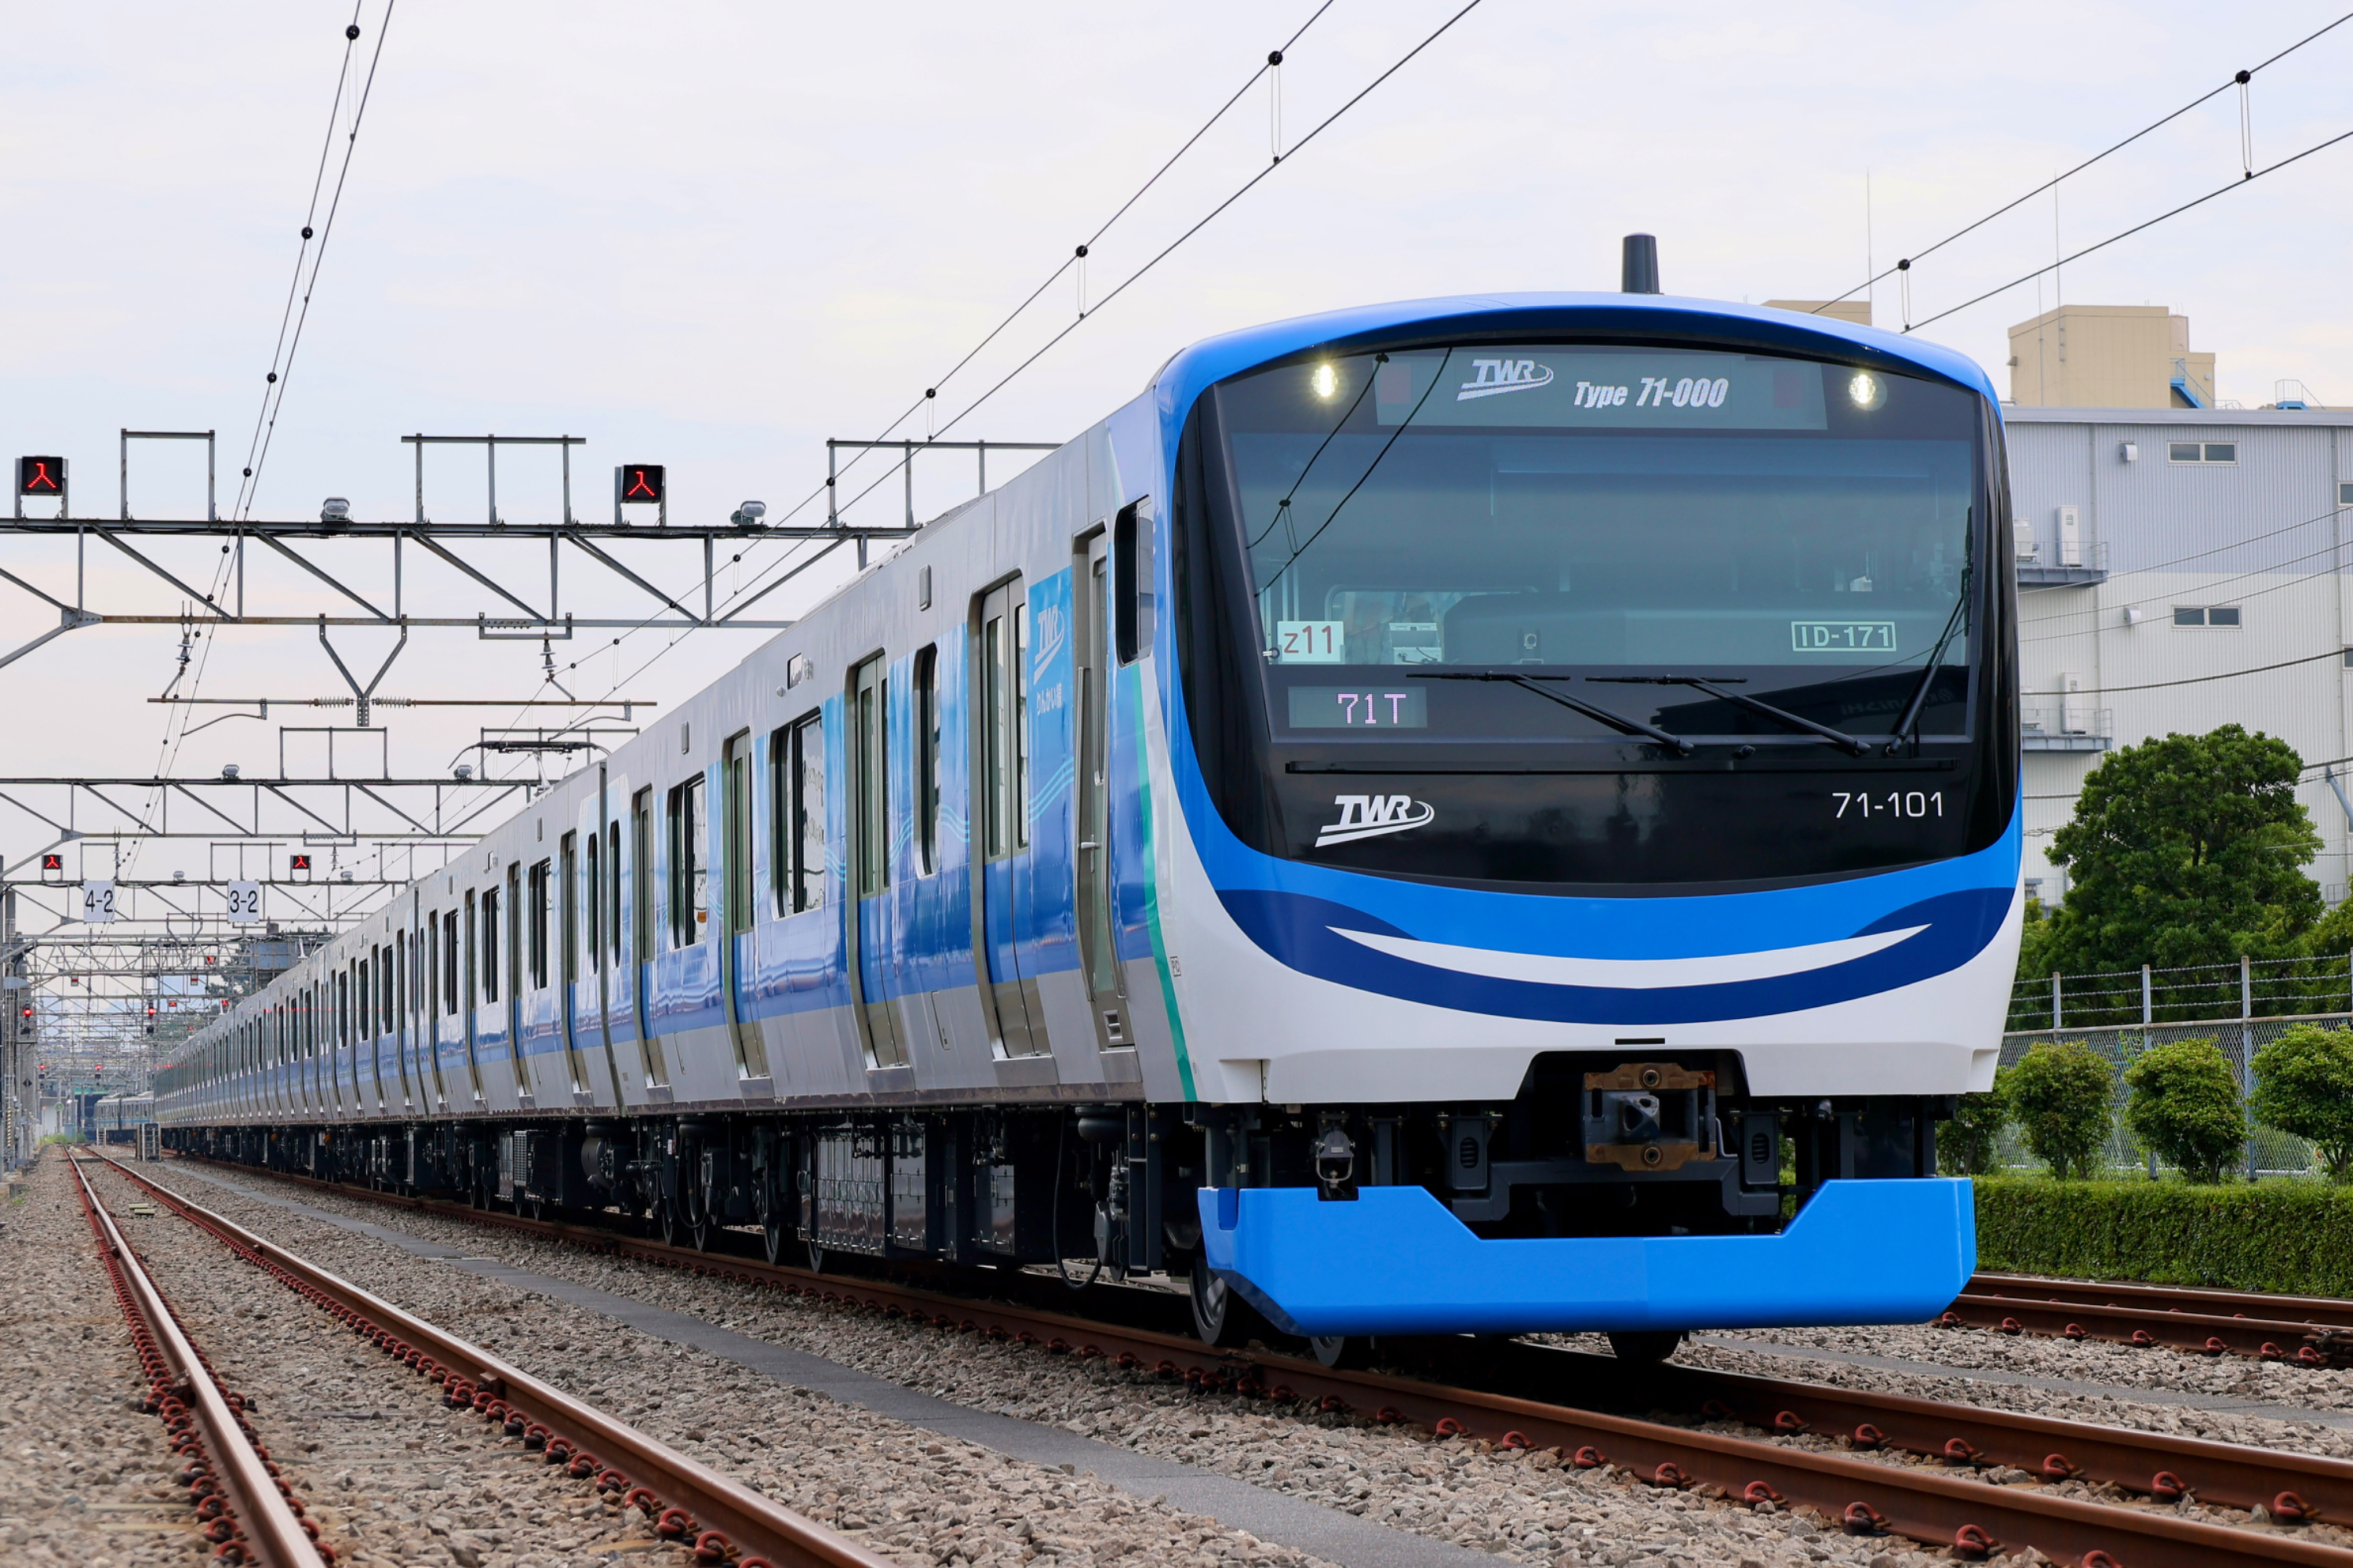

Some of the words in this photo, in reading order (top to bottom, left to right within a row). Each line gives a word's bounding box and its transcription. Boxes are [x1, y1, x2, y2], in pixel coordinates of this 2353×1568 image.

[1573, 381, 1629, 409] Type
[1635, 377, 1729, 408] 71-000
[1801, 626, 1889, 647] ID-171
[1337, 693, 1407, 724] 71T
[1831, 791, 1943, 818] 71-101
[85, 889, 115, 913] 4-2
[230, 890, 257, 913] 3-2
